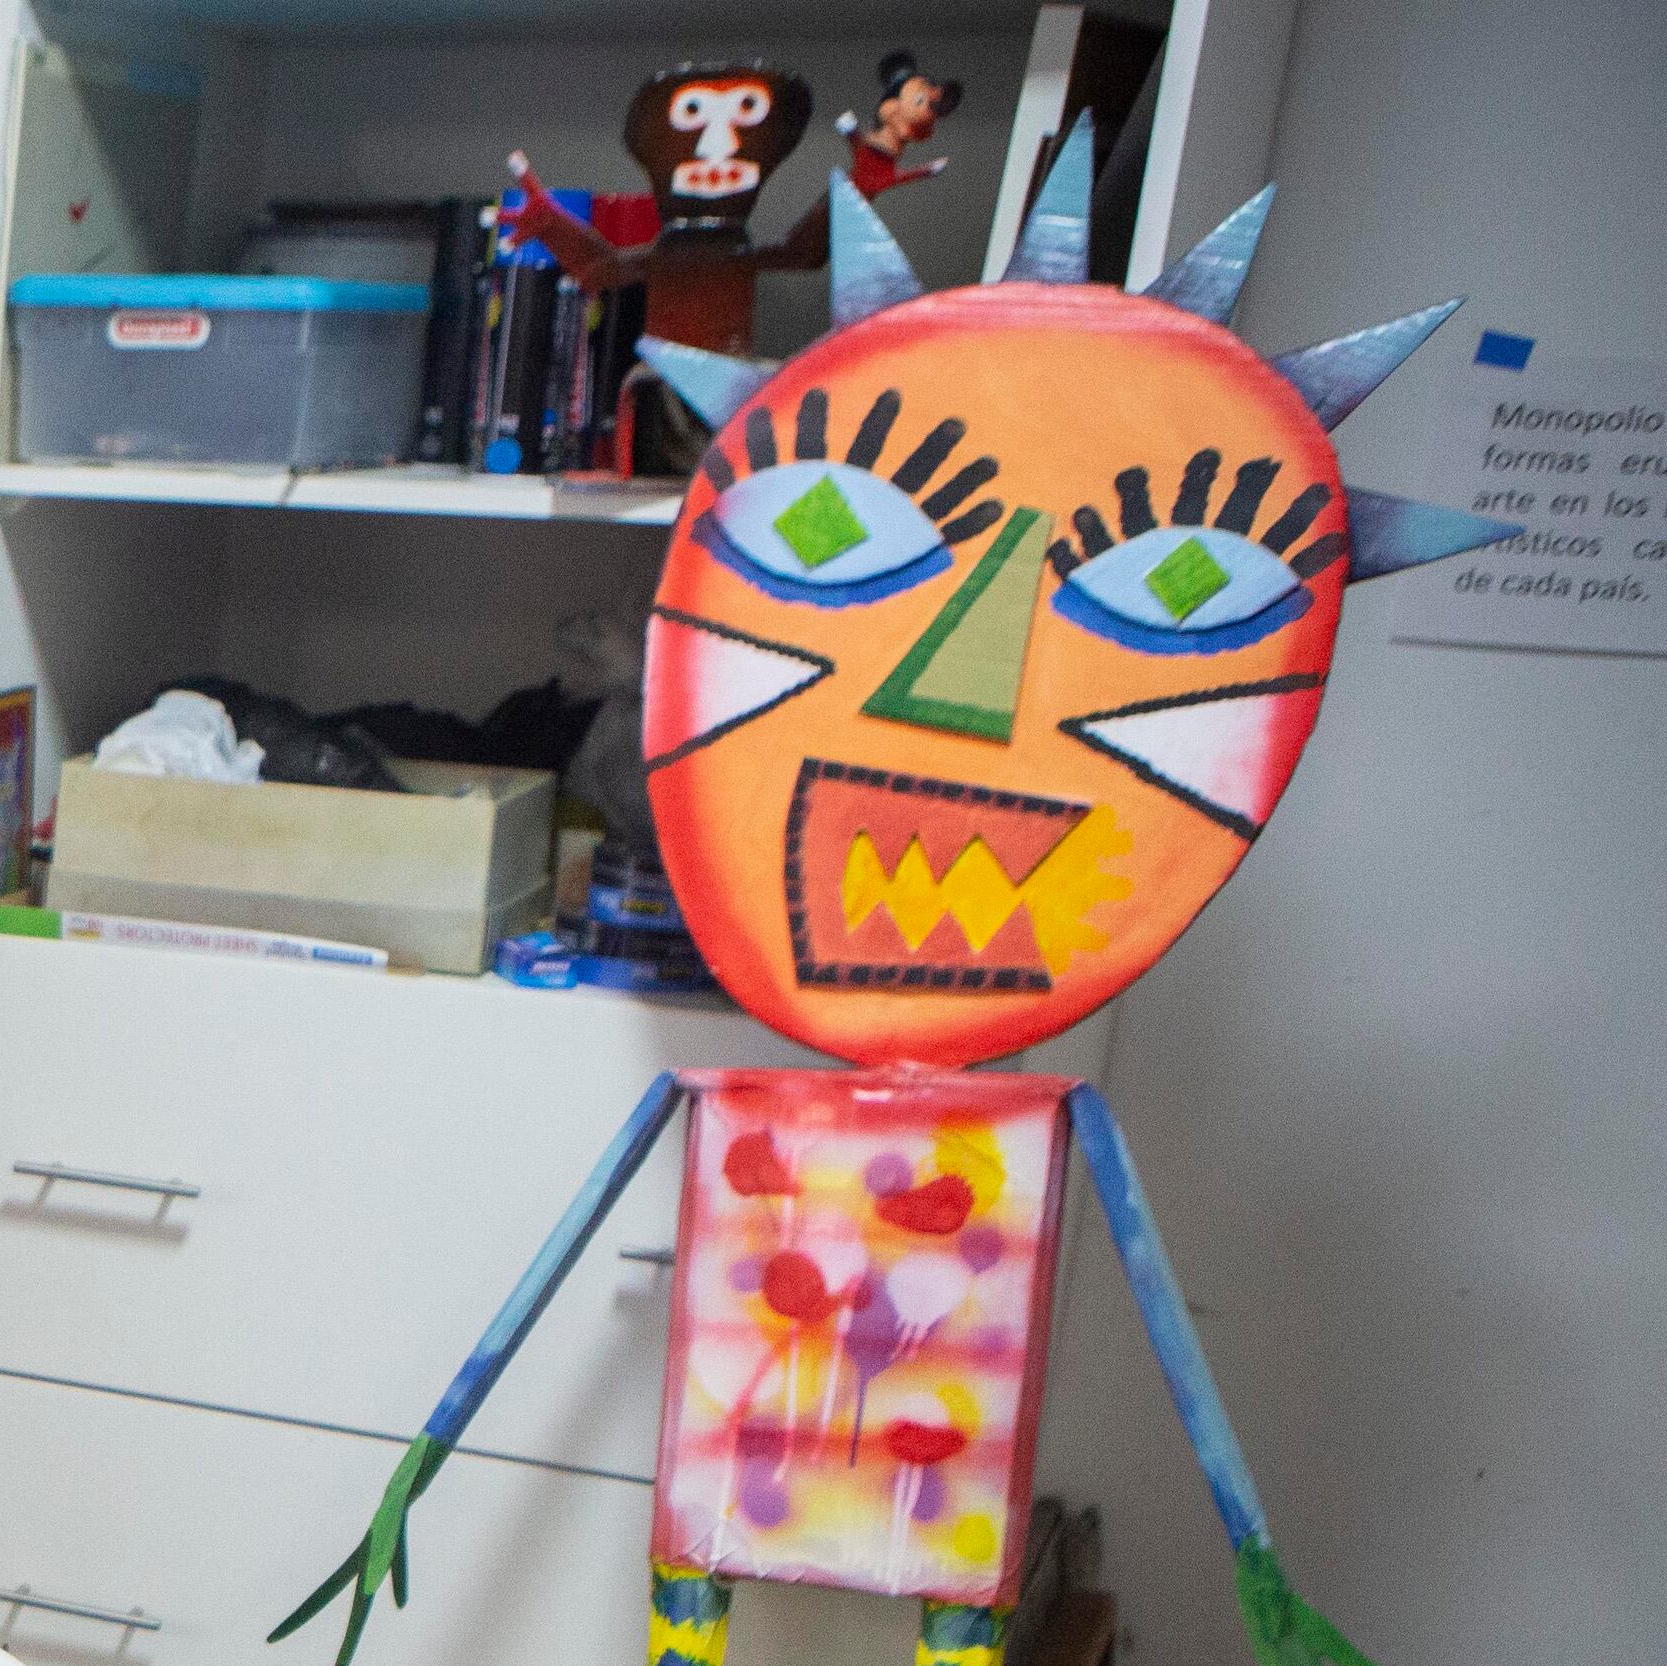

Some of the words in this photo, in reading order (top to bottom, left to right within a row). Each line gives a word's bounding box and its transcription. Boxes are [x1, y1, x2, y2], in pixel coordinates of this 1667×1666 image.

[1490, 402, 1665, 437] Monopolio
[1480, 442, 1592, 475] formas
[1471, 489, 1537, 515] arte
[1548, 494, 1591, 517] en
[1603, 488, 1651, 519] los
[1453, 566, 1493, 595] de
[1498, 569, 1573, 598] cada
